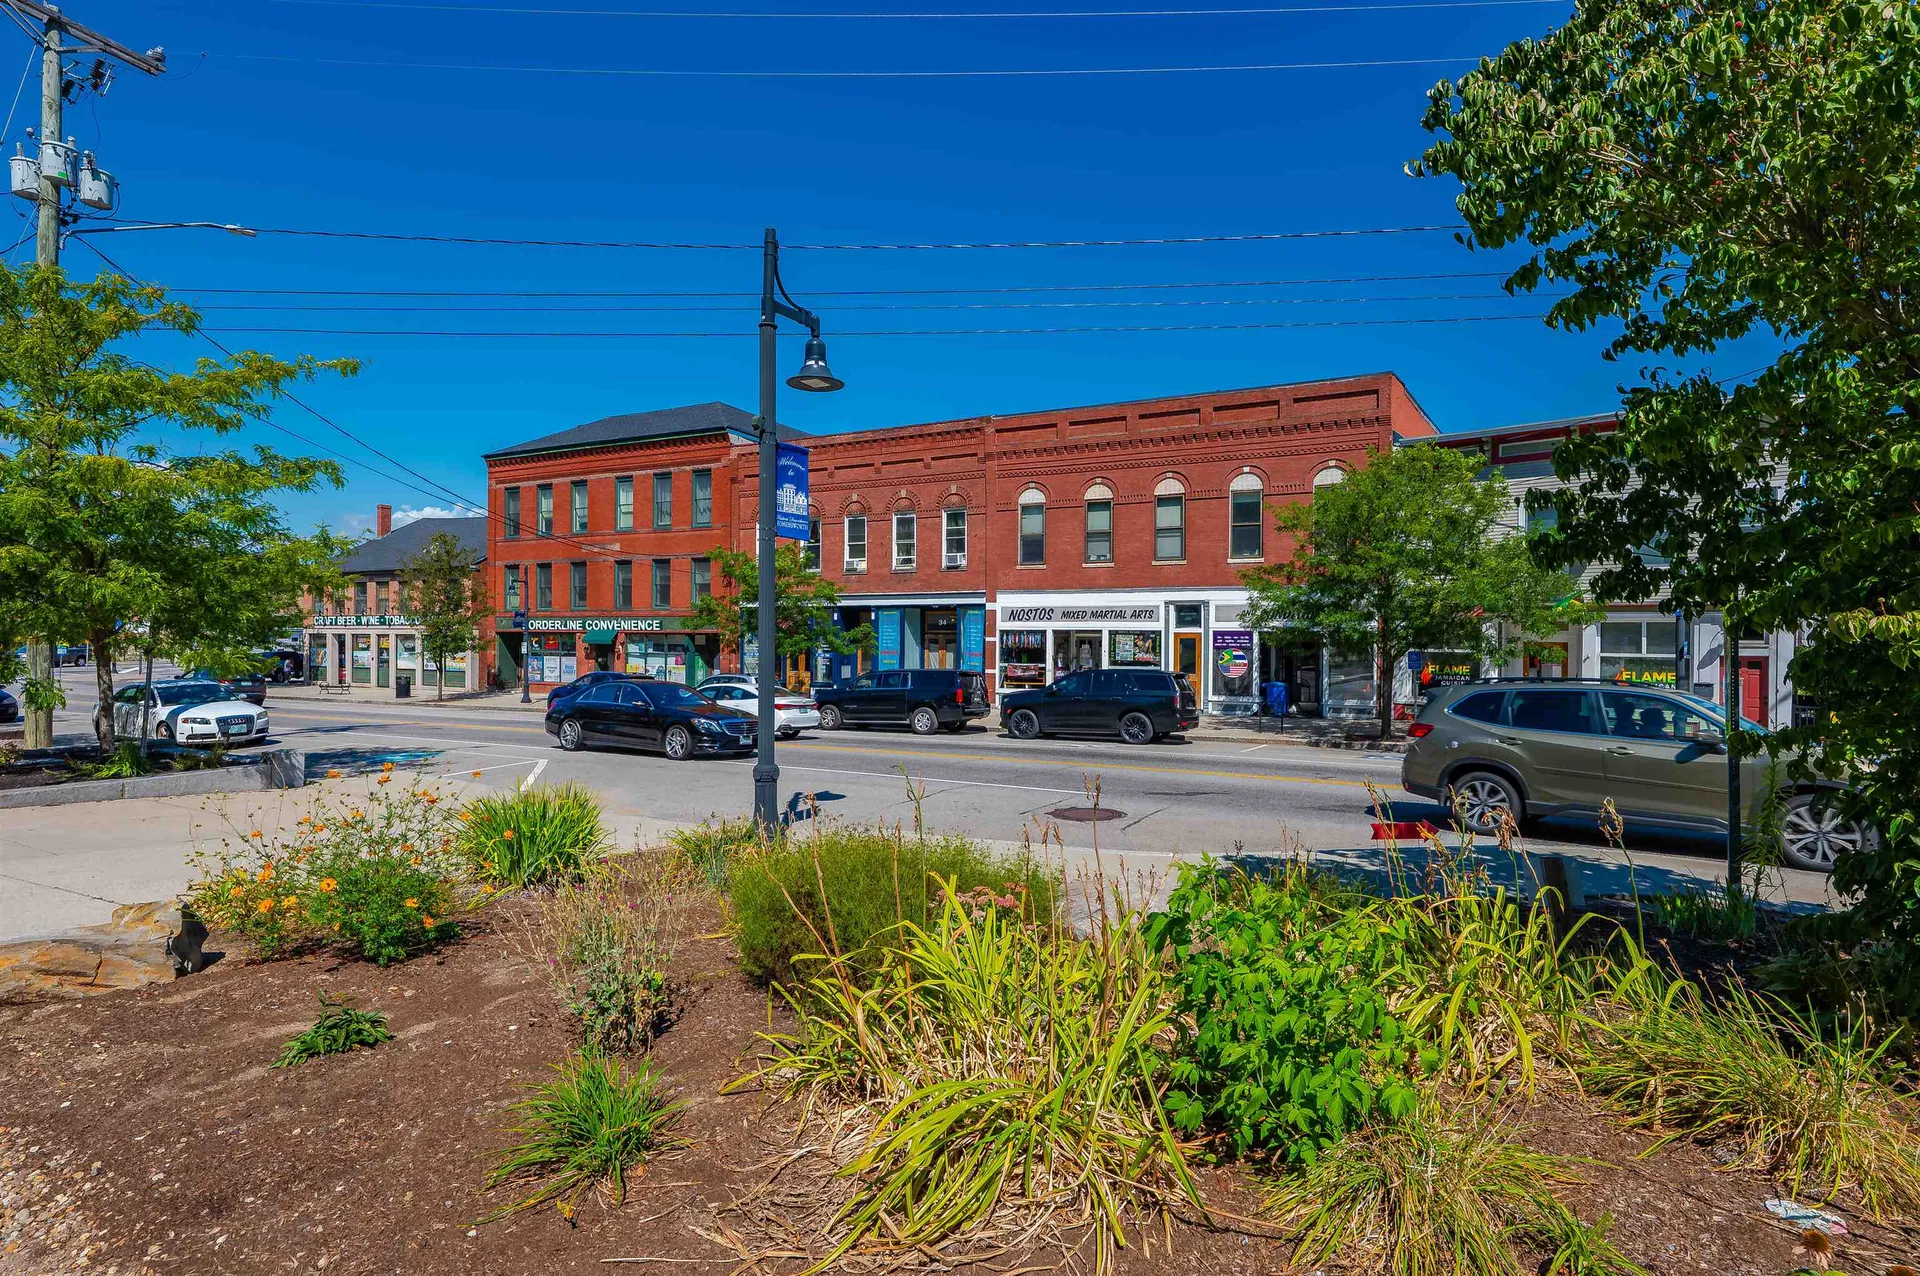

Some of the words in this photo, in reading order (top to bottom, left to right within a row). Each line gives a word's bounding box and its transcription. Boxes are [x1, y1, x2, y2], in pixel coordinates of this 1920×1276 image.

[313, 616, 336, 625] CRAFT
[337, 616, 356, 625] BEER
[361, 615, 380, 625] WINE
[1008, 608, 1054, 622] NOSTOS
[1060, 609, 1087, 620] MIXED
[1089, 609, 1127, 620] MARTIAL
[1129, 609, 1154, 620] ARTS
[585, 620, 661, 630] CONVENIENCE
[1428, 664, 1471, 675] FLAME
[1622, 671, 1676, 683] FLAME
